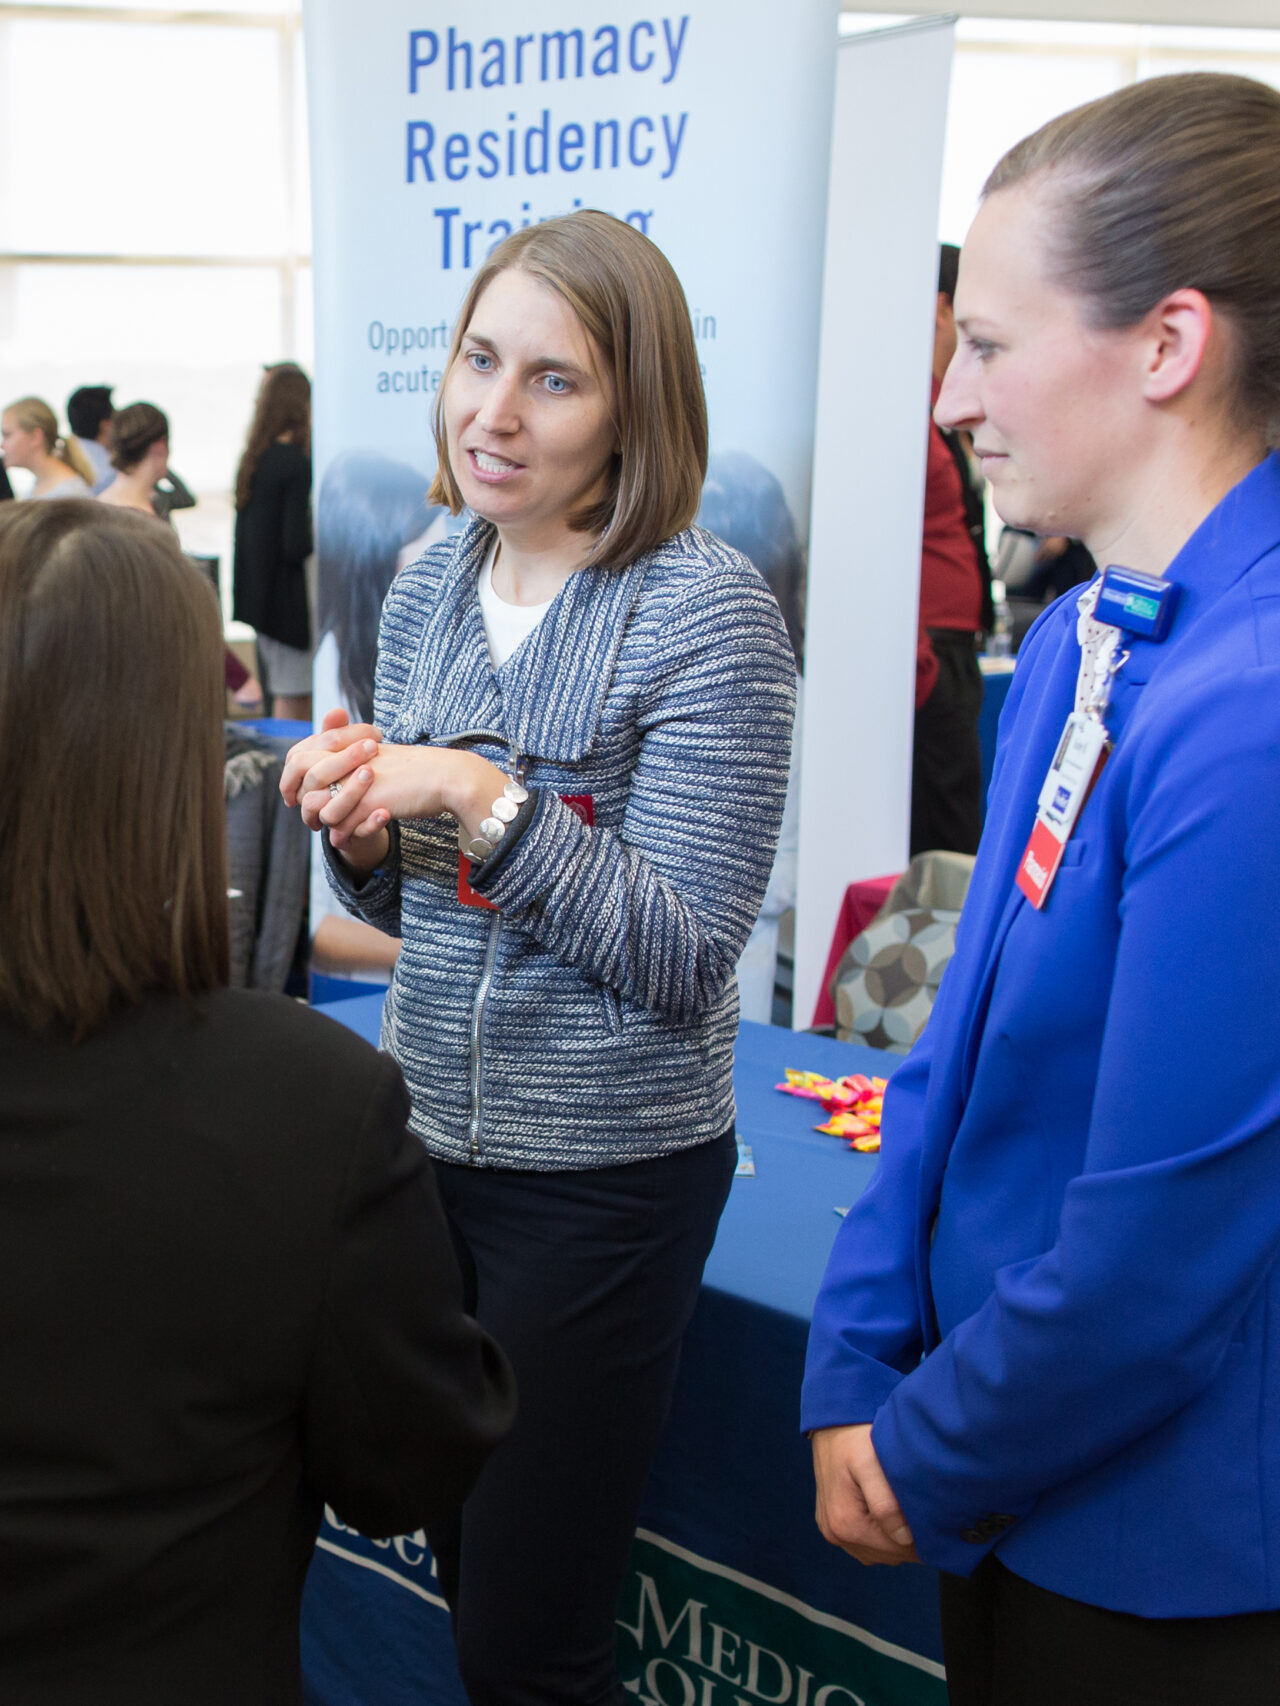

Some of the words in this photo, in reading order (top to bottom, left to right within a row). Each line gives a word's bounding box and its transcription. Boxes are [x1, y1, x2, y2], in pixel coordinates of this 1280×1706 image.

[409, 15, 690, 95] Pharmacy
[406, 109, 689, 183] Residency
[368, 320, 452, 356] Opport
[695, 308, 716, 339] in
